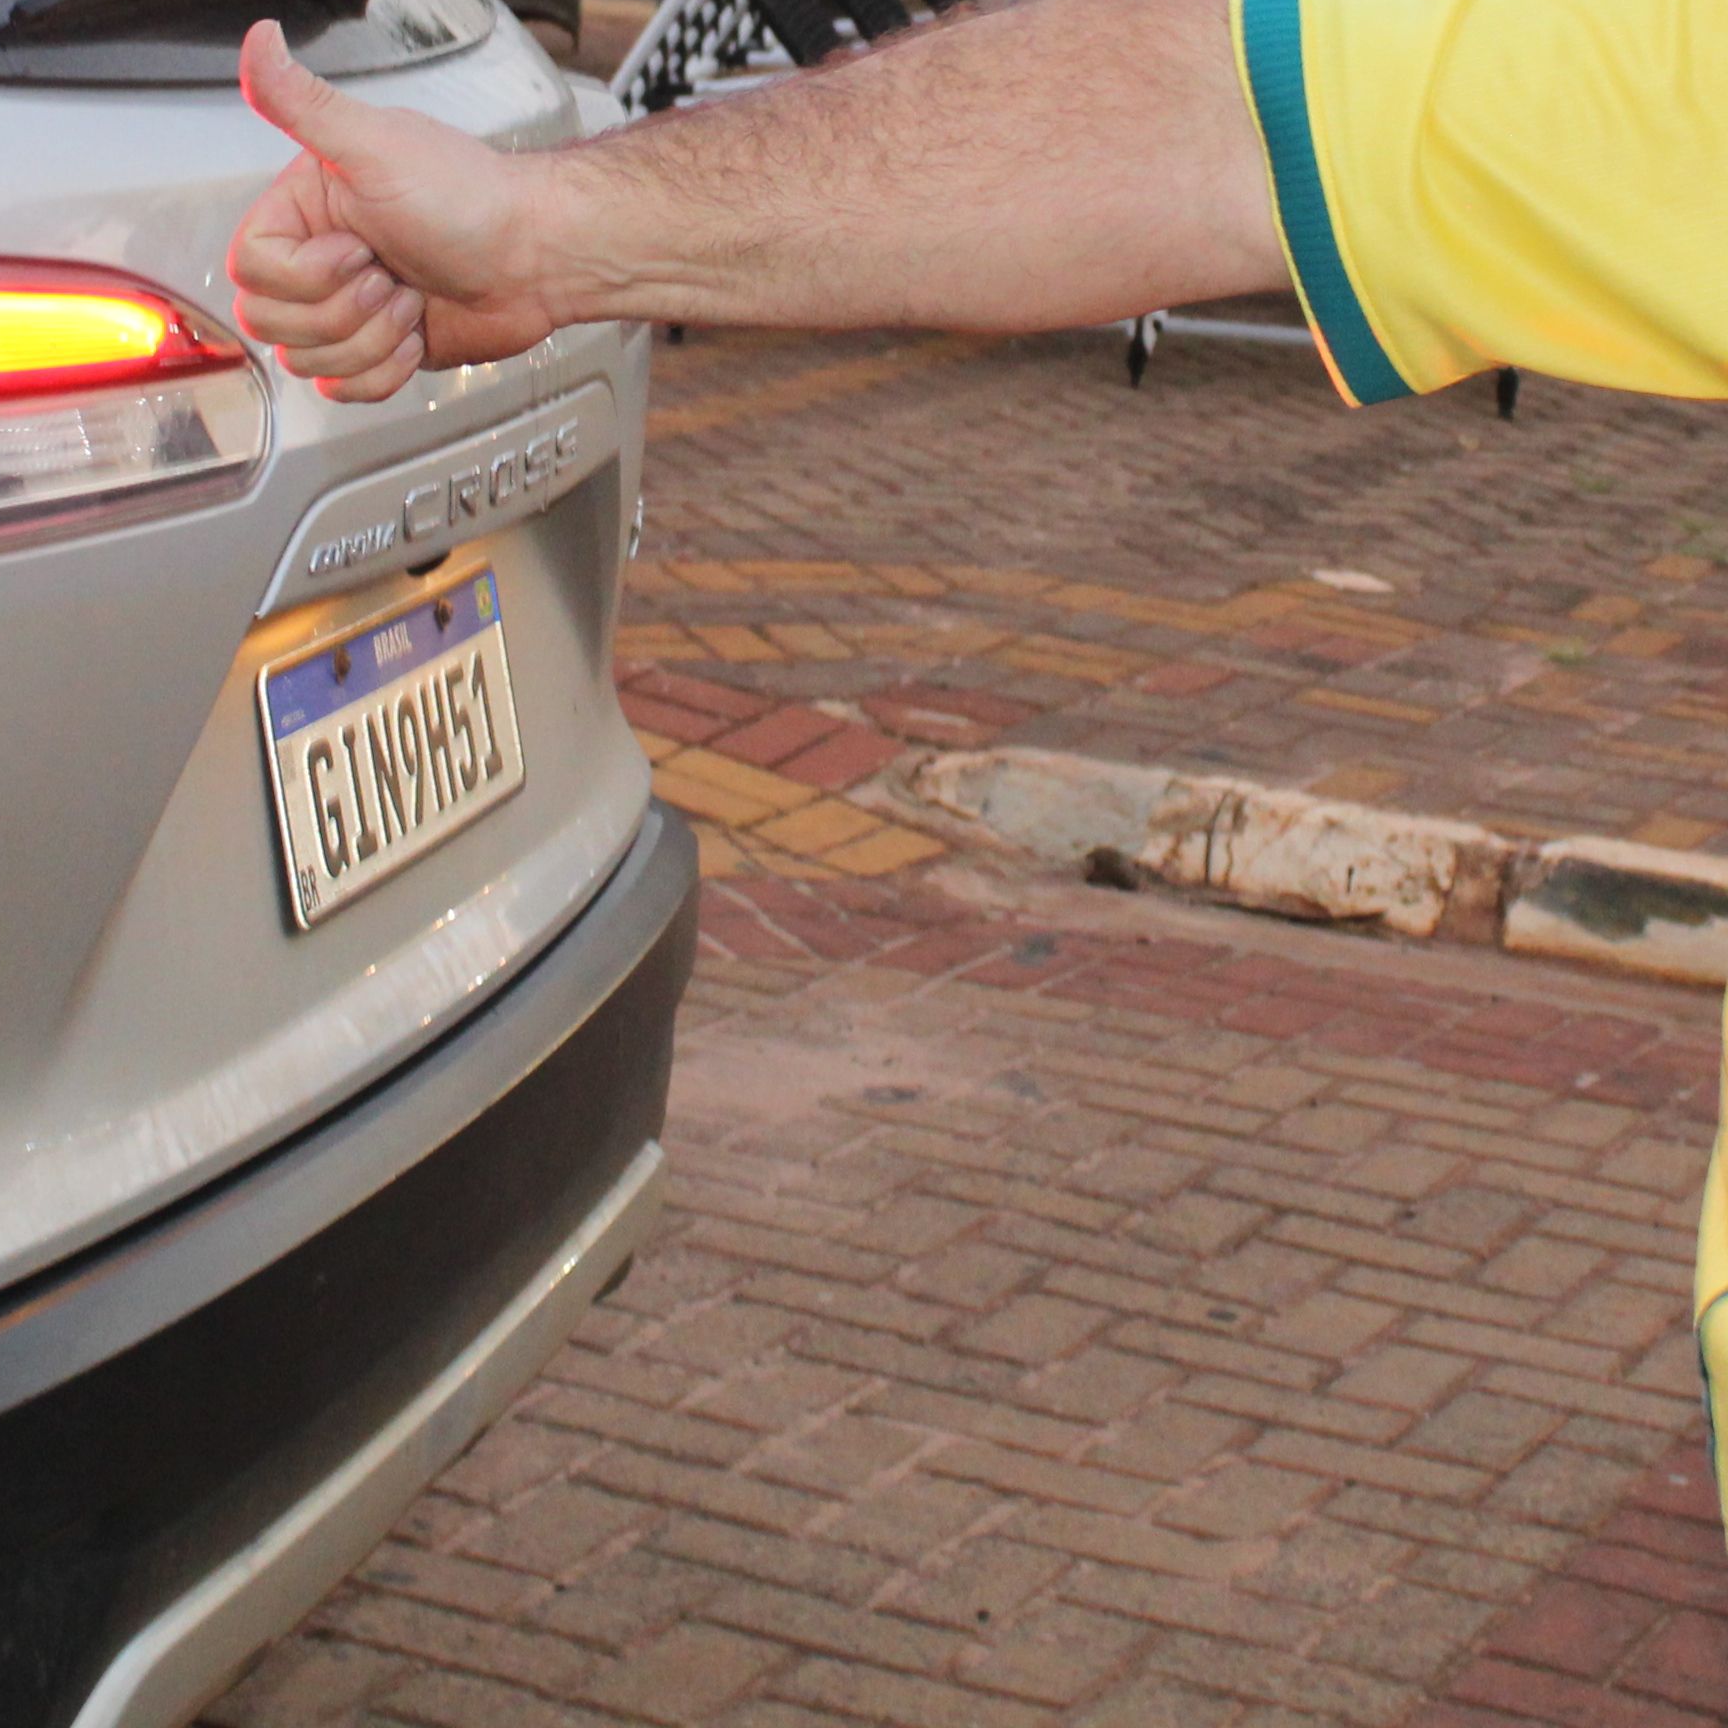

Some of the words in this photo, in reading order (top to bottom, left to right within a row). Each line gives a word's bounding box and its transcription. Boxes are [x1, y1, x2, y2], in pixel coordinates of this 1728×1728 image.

[402, 417, 579, 545] CROSS
[373, 621, 413, 668] BRASIL
[302, 649, 503, 879] GIN9H51
[300, 864, 321, 913] BR
